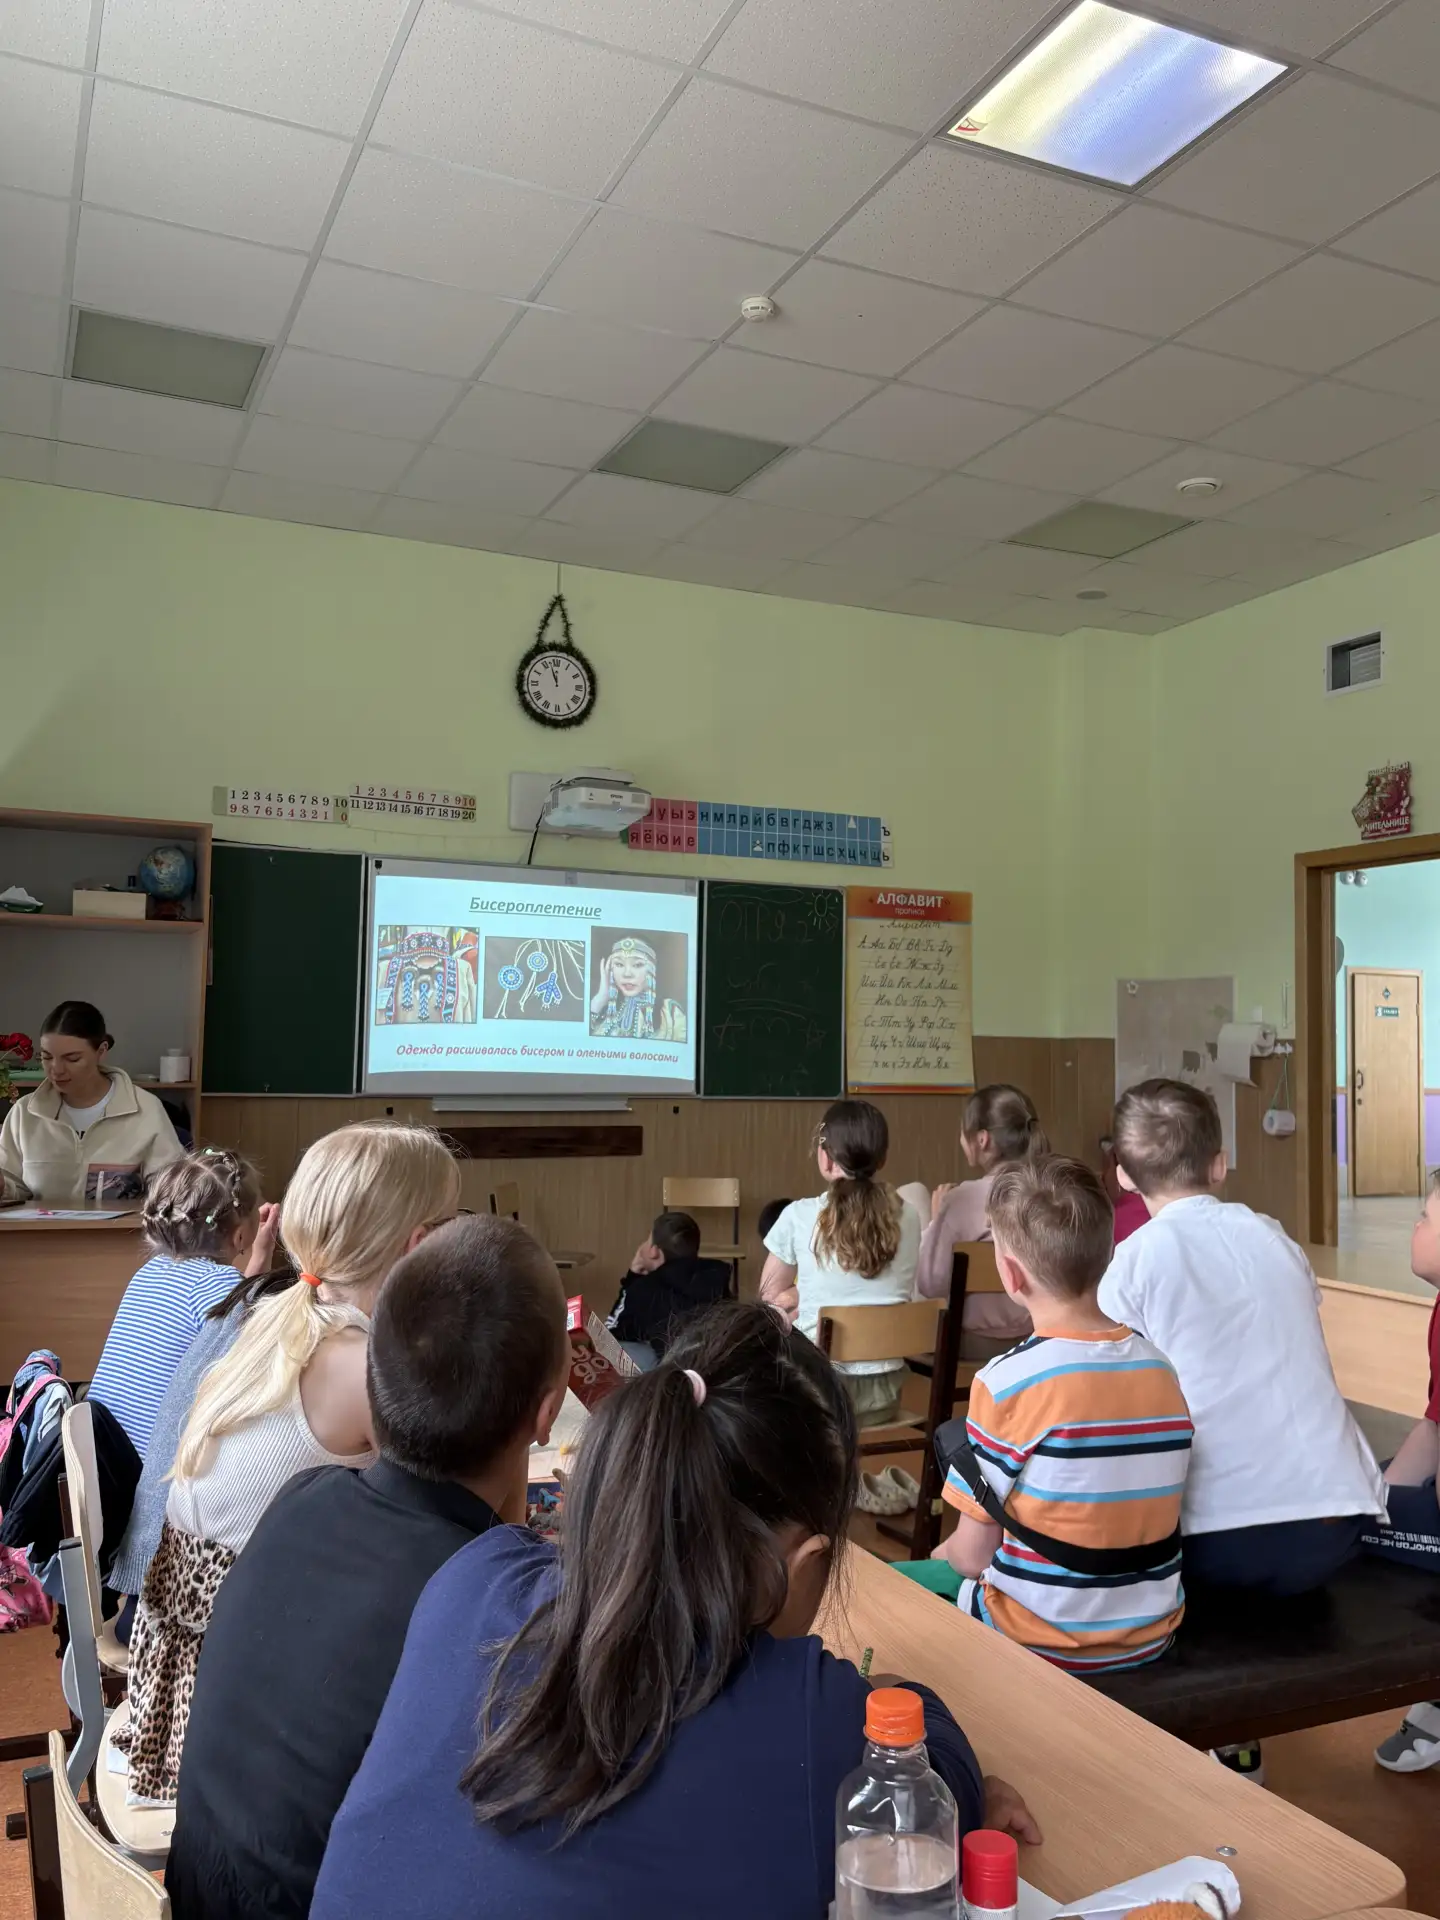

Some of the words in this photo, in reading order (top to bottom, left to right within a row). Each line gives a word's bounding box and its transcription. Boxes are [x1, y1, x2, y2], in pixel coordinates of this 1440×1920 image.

[230, 790, 236, 799] 1
[242, 791, 249, 800] 2
[254, 792, 261, 801] 3
[265, 793, 272, 801] 4
[276, 794, 283, 803] 5
[288, 795, 296, 803] 6
[300, 795, 307, 804] 7
[311, 796, 318, 805] 8
[322, 797, 329, 806] 9
[335, 798, 348, 808] 10
[356, 786, 360, 794] 1
[368, 787, 375, 796] 2
[380, 788, 387, 797] 3
[393, 790, 399, 798] 4
[406, 791, 412, 800] 5
[418, 792, 424, 801] 6
[431, 794, 437, 802] 7
[443, 795, 449, 803] 8
[455, 796, 461, 805] 9
[462, 798, 475, 807] 10
[230, 804, 237, 813] 9
[242, 805, 249, 814] 8
[254, 806, 261, 815] 7
[265, 806, 272, 816] 6
[277, 808, 283, 817] 5
[288, 808, 295, 817] 4
[300, 809, 307, 818] 3
[312, 810, 318, 819] 2
[324, 812, 328, 820] 1
[341, 812, 348, 821] 0
[351, 800, 360, 808] 11
[363, 801, 373, 810] 12
[376, 802, 386, 811] 13
[388, 804, 398, 813] 14
[401, 804, 411, 814] 15
[414, 806, 423, 815] 16
[426, 807, 436, 816] 17
[438, 808, 448, 817] 18
[450, 810, 460, 818] 19
[462, 811, 474, 820] 20
[470, 897, 602, 917] Бисероплетение
[877, 893, 944, 908] АЛФАВИТ
[396, 1044, 443, 1055] Одежда
[446, 1046, 518, 1056] расшивалась
[520, 1045, 564, 1058] бисером
[568, 1049, 574, 1057] и
[576, 1050, 627, 1059] оленьими
[630, 1051, 679, 1063] волосами
